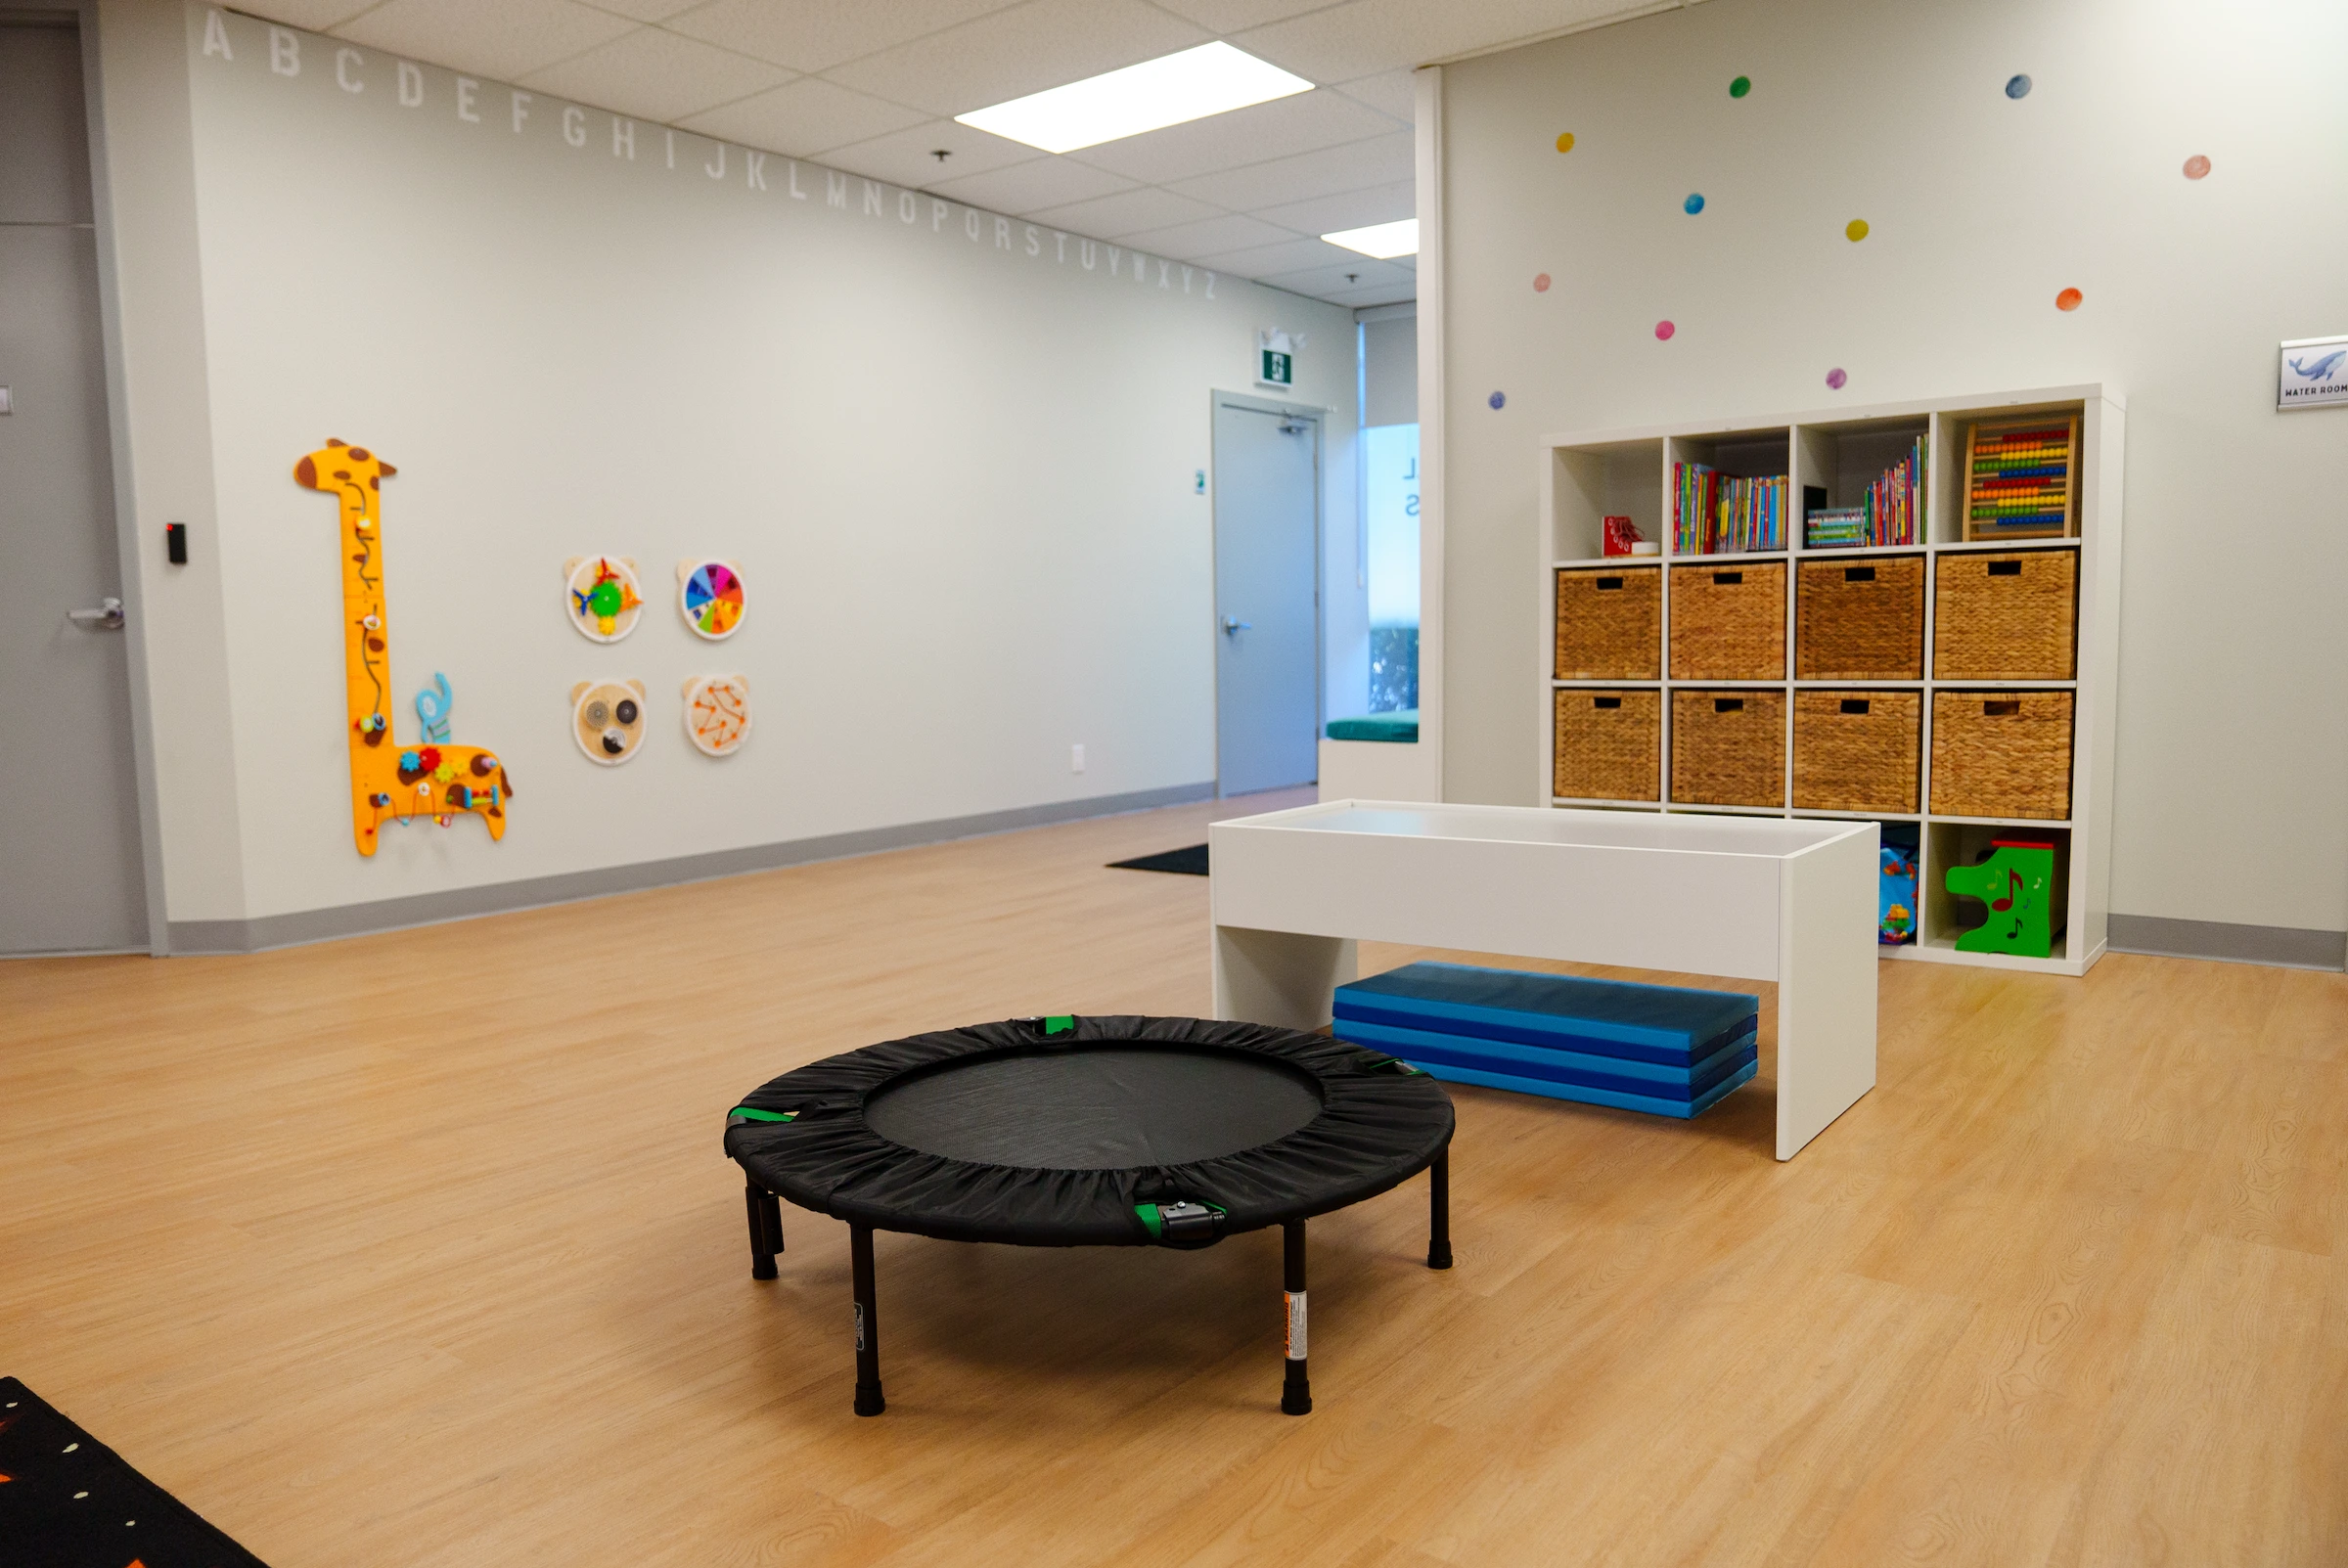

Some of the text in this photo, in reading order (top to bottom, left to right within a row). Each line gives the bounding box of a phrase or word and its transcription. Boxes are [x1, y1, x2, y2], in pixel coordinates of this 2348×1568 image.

[203, 12, 234, 61] A
[269, 27, 301, 77] B
[335, 49, 364, 93] C
[398, 63, 423, 108] D
[457, 77, 480, 122] E
[512, 91, 531, 134] F
[563, 108, 586, 147] G
[613, 117, 635, 160] H
[666, 130, 675, 169] I
[705, 144, 726, 180] J
[746, 153, 767, 191] K
[789, 162, 806, 200] L
[827, 172, 846, 209] M
[864, 183, 882, 217] N
[898, 193, 916, 225] O
[933, 200, 948, 232] P
[996, 219, 1011, 250] R
[1025, 225, 1040, 256] S
[1053, 234, 1067, 263] T
[1081, 240, 1096, 271] U
[1158, 261, 1170, 290] X
[1180, 266, 1193, 294] Y
[1205, 273, 1216, 299] Z
[2285, 384, 2348, 397] WATER ROOM
